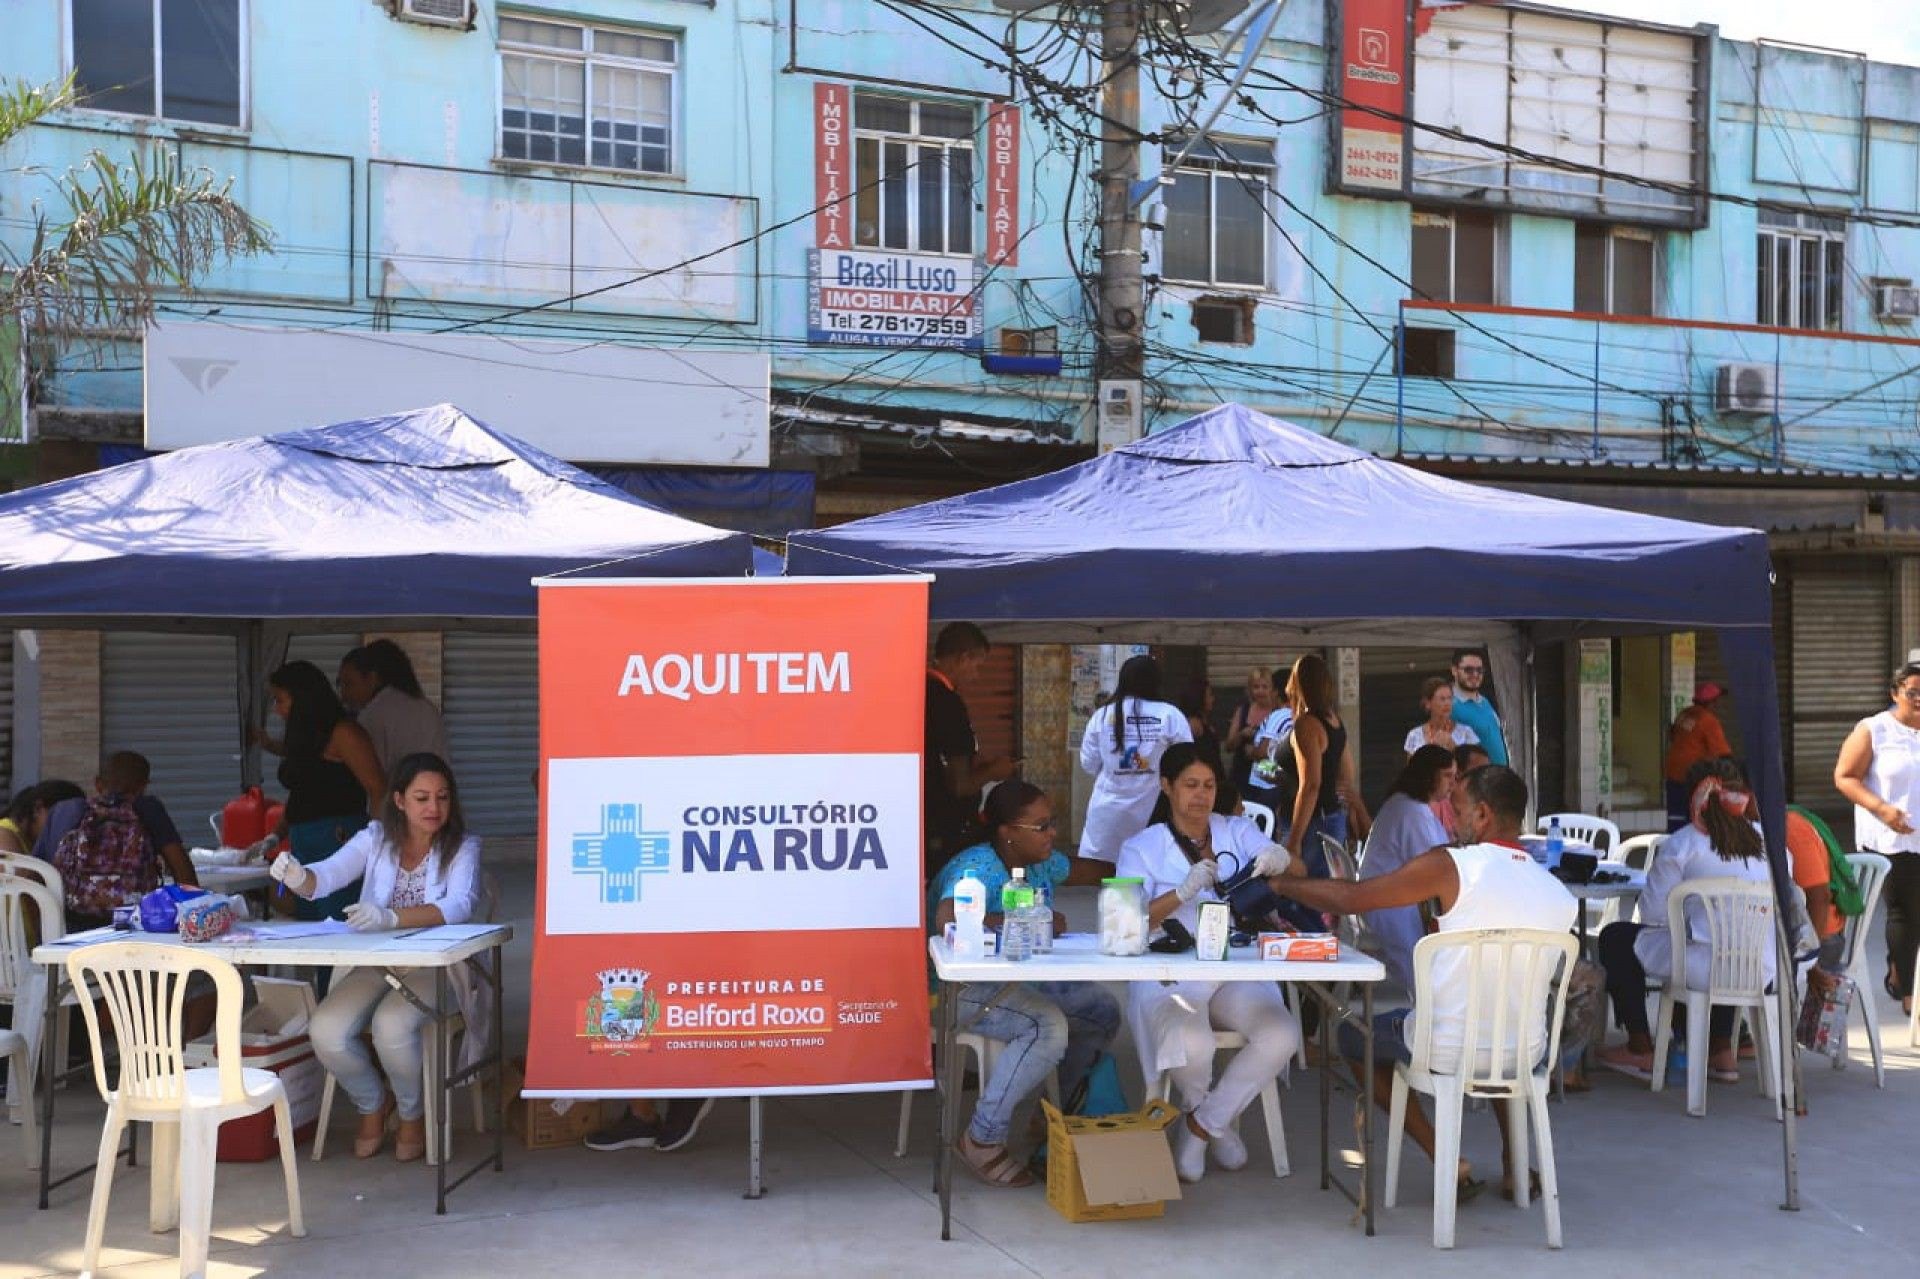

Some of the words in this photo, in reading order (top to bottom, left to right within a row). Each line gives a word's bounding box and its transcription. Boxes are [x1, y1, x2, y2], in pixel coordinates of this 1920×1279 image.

[1347, 65, 1399, 83] Bradesco
[838, 255, 898, 288] Brasil
[906, 259, 956, 292] Luso
[618, 653, 741, 699] AQUI
[747, 651, 851, 694] TEM
[683, 800, 878, 826] CONSULTÓRIO
[682, 831, 764, 873] NA
[773, 827, 889, 871] RUA
[667, 980, 795, 995] PREFEITURA
[800, 979, 825, 992] DE
[666, 1002, 757, 1028] Belford
[762, 1003, 825, 1026] Roxo
[839, 1009, 883, 1024] SAÚDE
[666, 1040, 737, 1049] CONSTRUINDO
[740, 1040, 756, 1048] UM
[759, 1039, 788, 1048] NOVO
[791, 1037, 825, 1046] TEMPO
